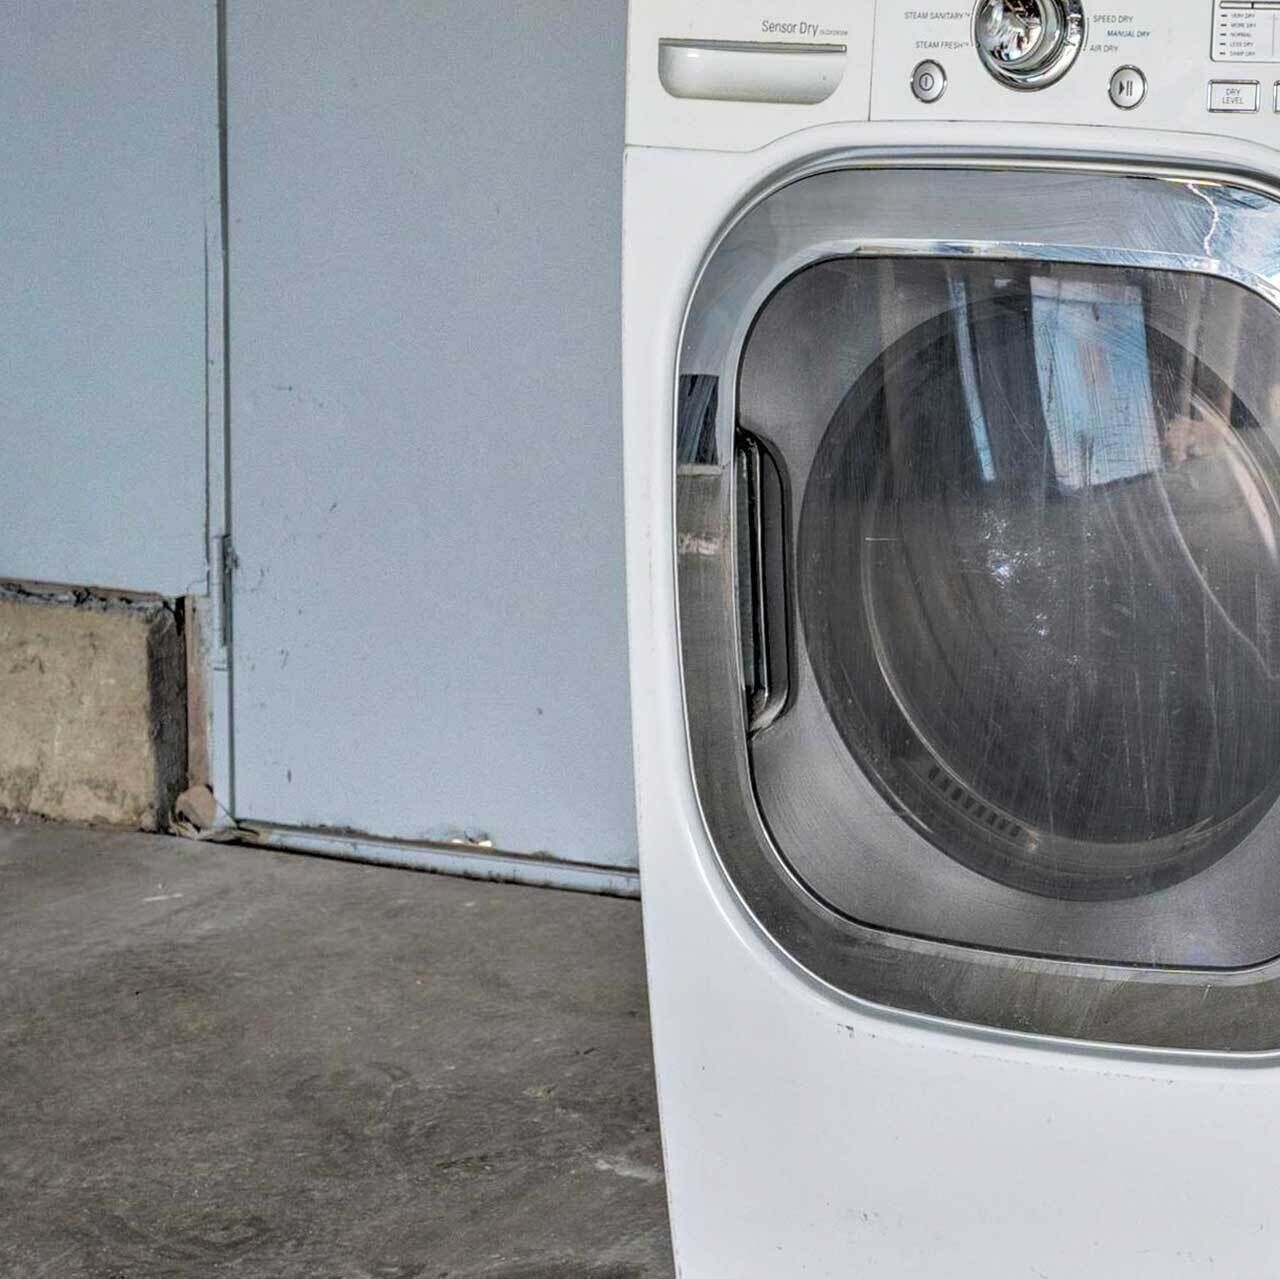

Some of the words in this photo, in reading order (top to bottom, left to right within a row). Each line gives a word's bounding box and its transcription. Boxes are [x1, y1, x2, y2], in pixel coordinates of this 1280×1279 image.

[904, 11, 928, 20] STEAM
[1093, 15, 1116, 24] SPEED
[1118, 15, 1134, 24] DRY
[761, 20, 797, 34] Sensor
[799, 22, 819, 37] Dry
[1107, 30, 1135, 38] MANUAL
[1136, 30, 1151, 38] DRY
[915, 41, 940, 49] STEAM
[1104, 45, 1119, 53] DRY
[1225, 88, 1240, 97] DRY
[1222, 97, 1244, 105] LEVEL
